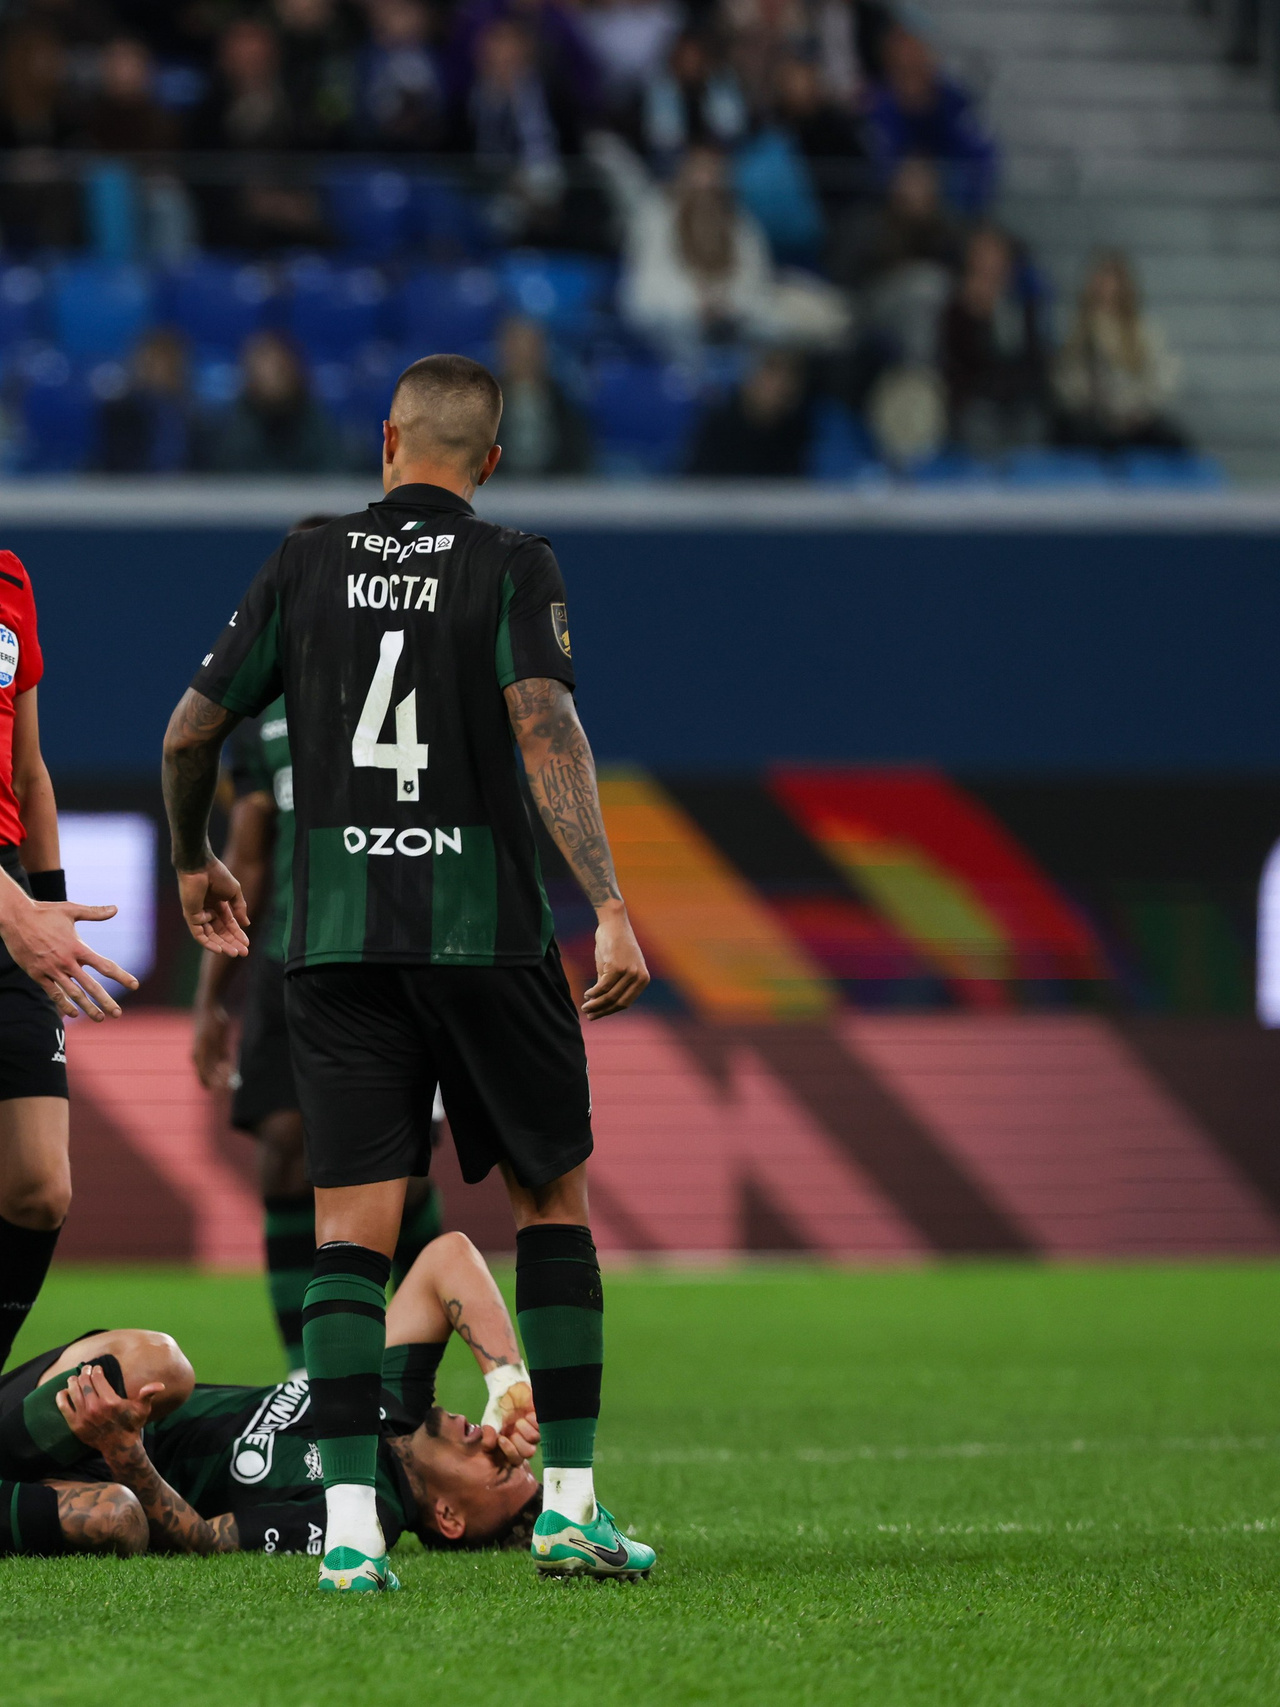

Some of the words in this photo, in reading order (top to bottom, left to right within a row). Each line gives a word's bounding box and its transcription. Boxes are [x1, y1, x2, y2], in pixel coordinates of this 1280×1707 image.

[347, 573, 439, 613] КОСТА
[352, 629, 429, 802] 4
[343, 826, 462, 857] OZON
